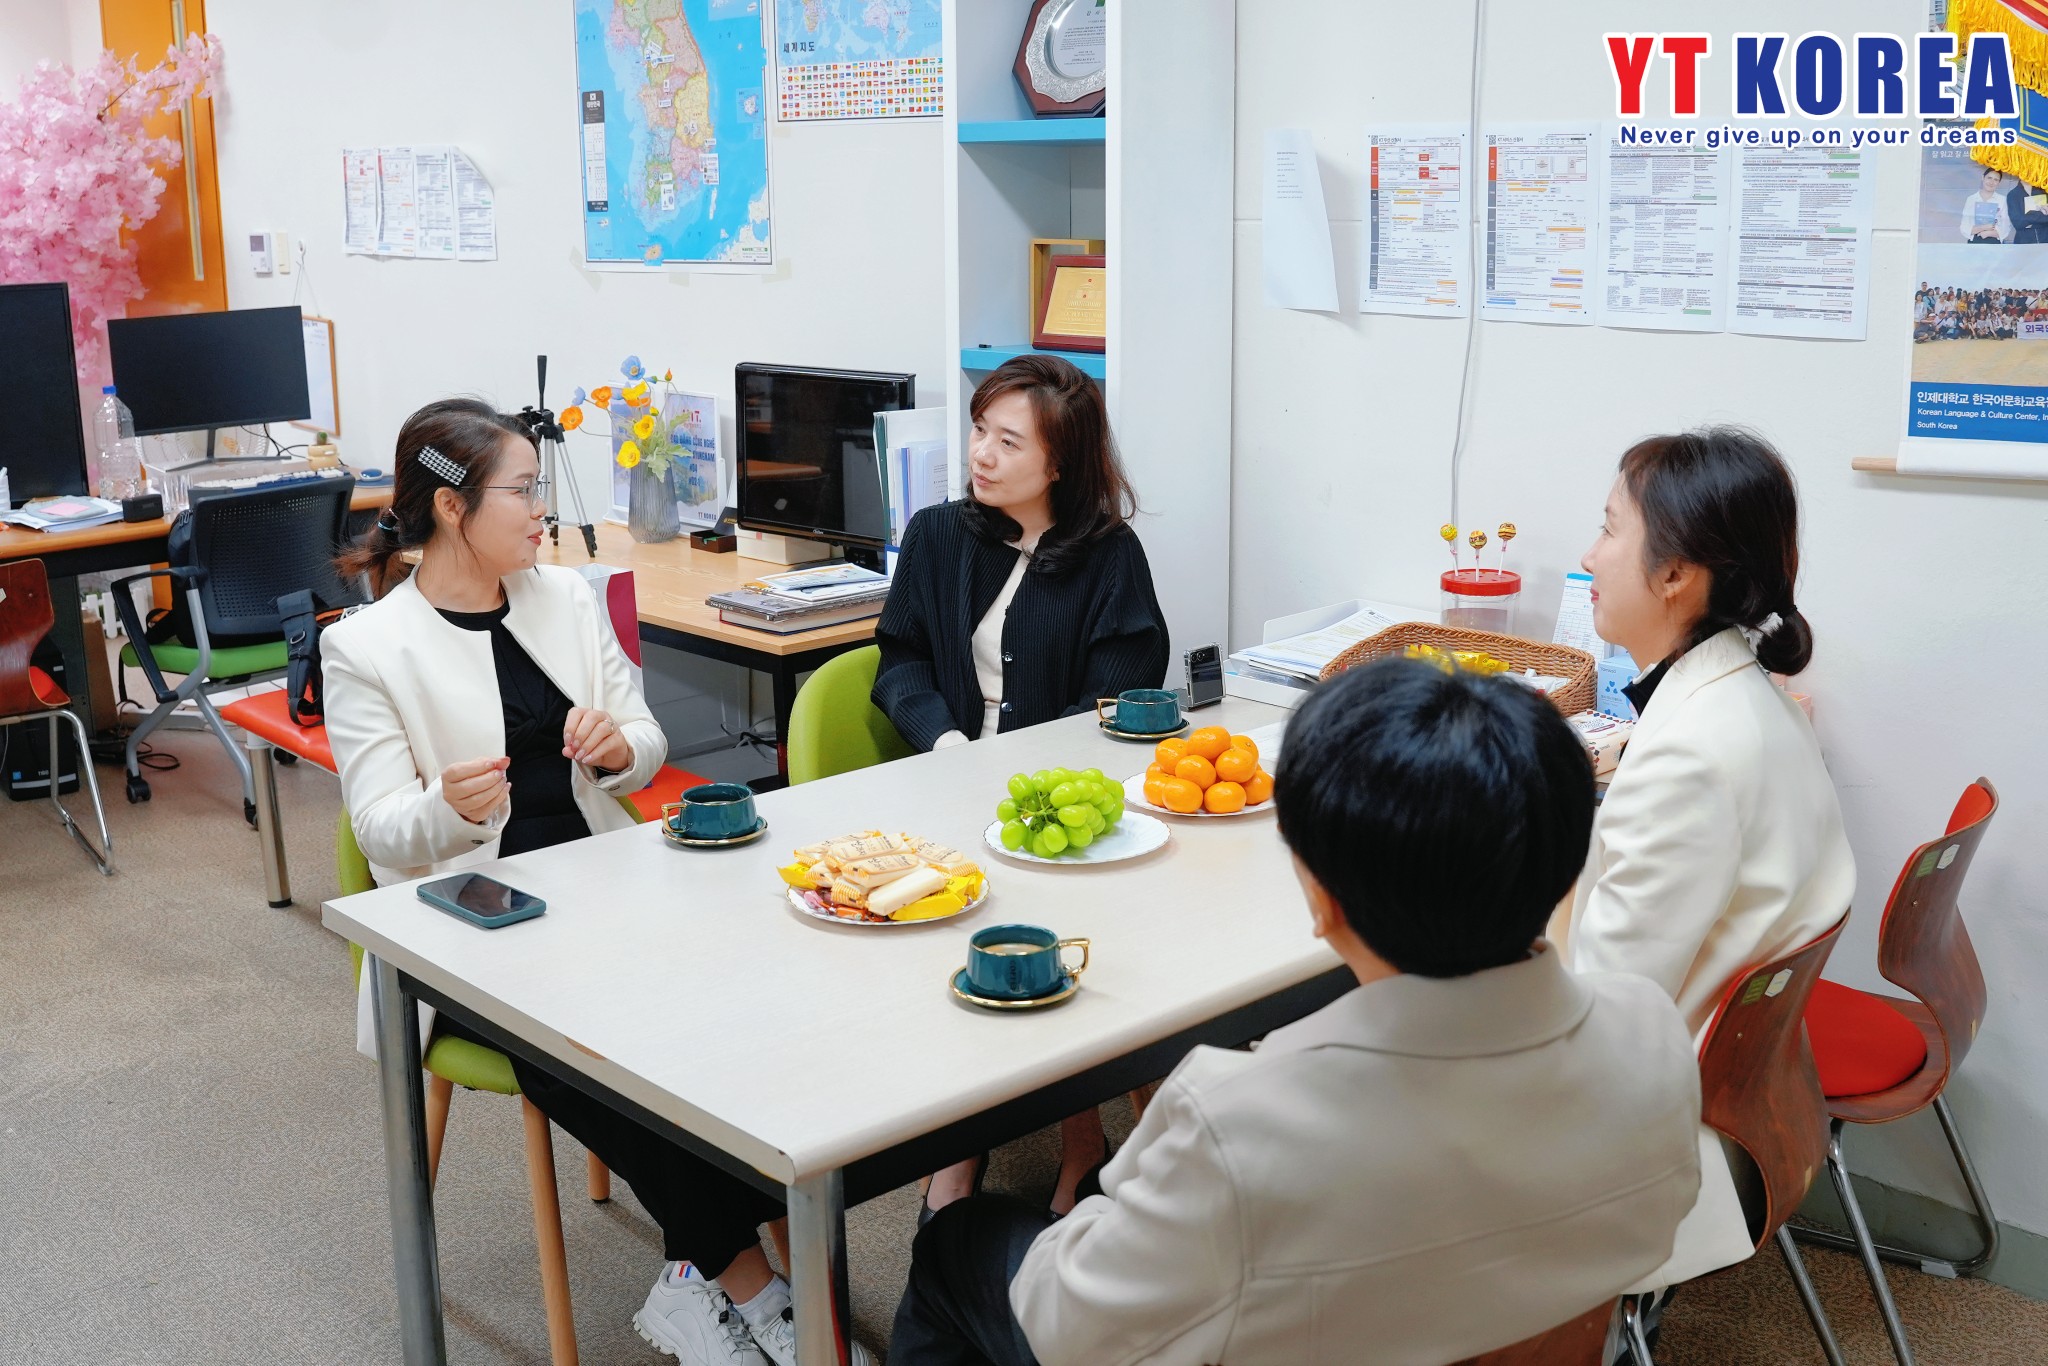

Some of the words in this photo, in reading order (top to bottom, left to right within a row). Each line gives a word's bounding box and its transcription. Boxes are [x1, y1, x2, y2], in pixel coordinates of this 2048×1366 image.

[783, 41, 815, 53] 세계지도
[1917, 391, 1969, 404] 인제대학교
[1972, 393, 2048, 408] 한국어문화교육
[1917, 407, 1943, 416] Korean
[1944, 409, 1979, 418] Language
[1980, 410, 1986, 418] &
[1987, 411, 2014, 420] Culture
[2014, 412, 2041, 421] Center,
[1917, 420, 1936, 429] South
[1937, 421, 1958, 430] Korea
